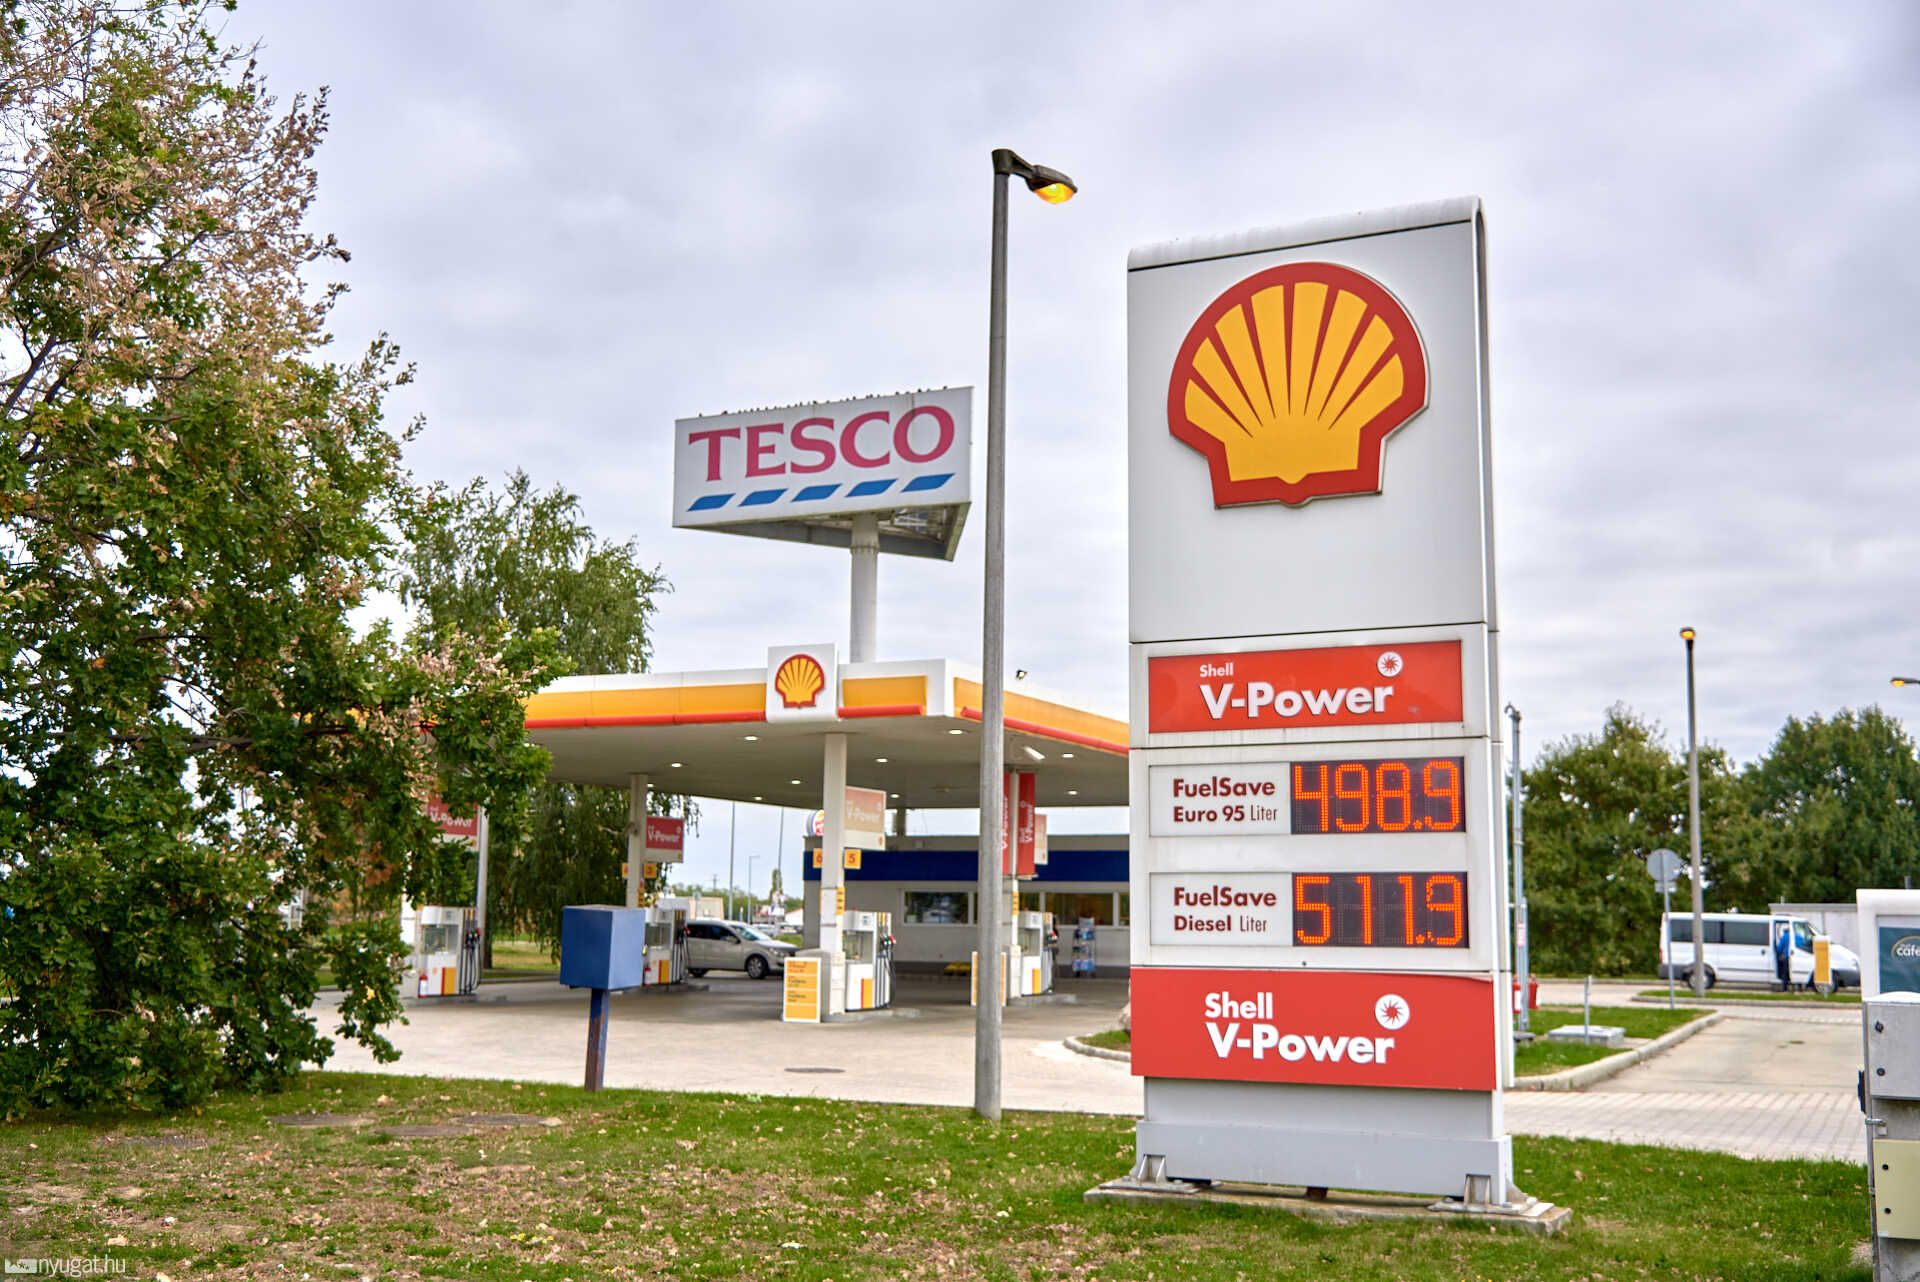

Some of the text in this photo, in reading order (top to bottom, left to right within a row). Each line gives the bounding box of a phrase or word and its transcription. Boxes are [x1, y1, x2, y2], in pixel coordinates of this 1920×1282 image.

[688, 405, 955, 482] TESCO
[1199, 662, 1234, 677] Shell
[1200, 681, 1394, 720] V-Power
[1173, 777, 1276, 798] FuelSave
[1294, 761, 1460, 832] 498.9
[1173, 804, 1278, 822] Euro 95 Liter
[848, 853, 856, 864] 5
[1173, 885, 1277, 907] FuelSave
[1295, 875, 1463, 945] 511.9
[1174, 915, 1267, 933] Diesel Liter
[1204, 992, 1273, 1020] Shell
[1205, 1022, 1395, 1064] V-Power
